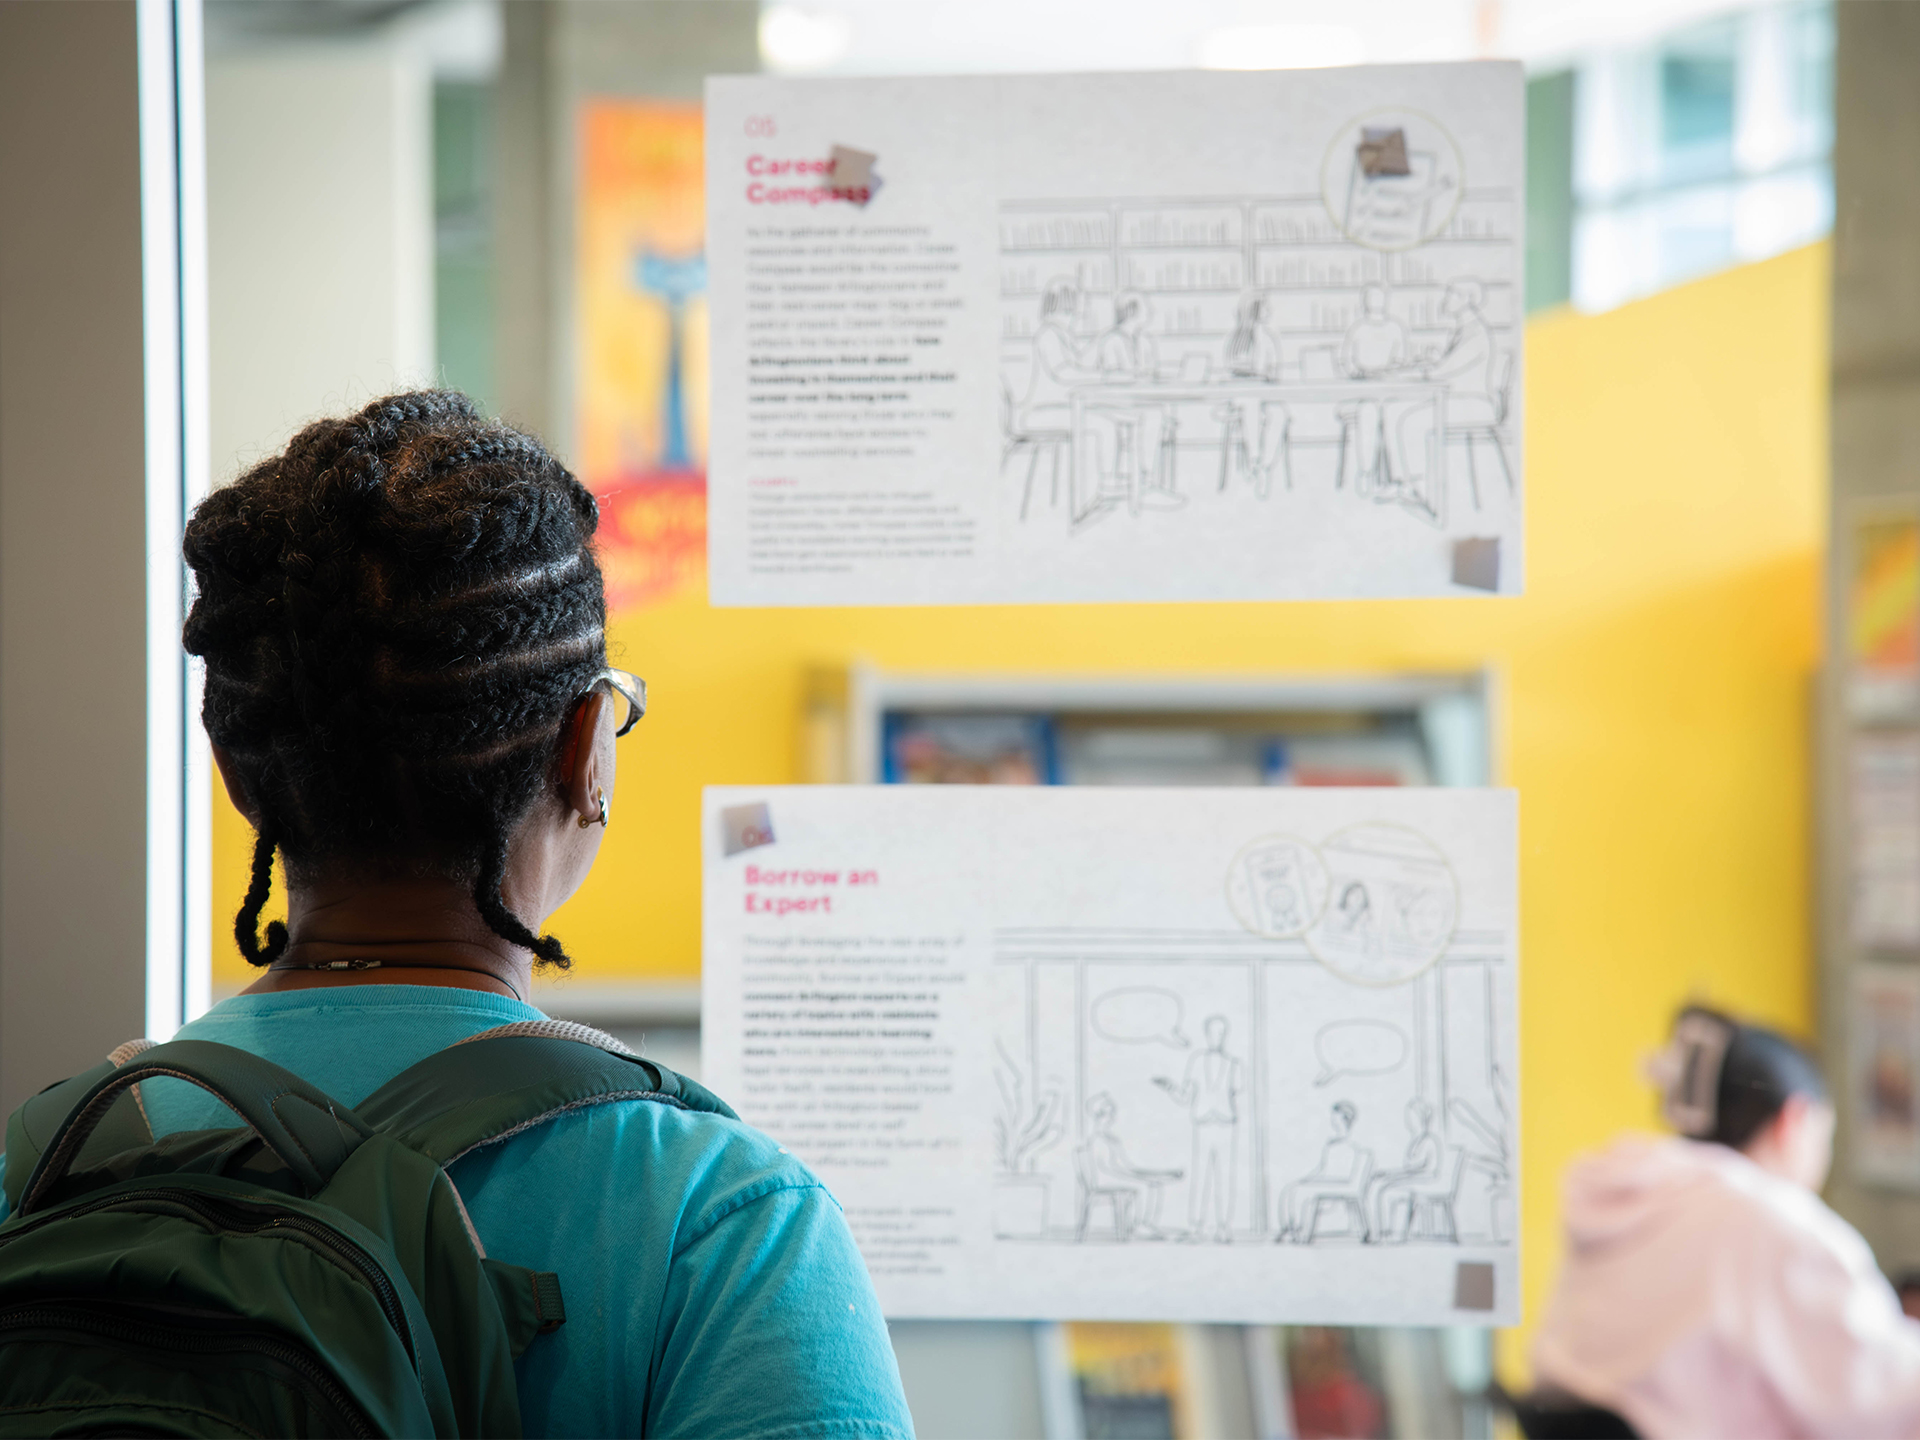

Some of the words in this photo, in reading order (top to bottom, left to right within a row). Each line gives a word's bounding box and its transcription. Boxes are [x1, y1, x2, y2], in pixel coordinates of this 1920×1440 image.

[746, 155, 839, 176] Career
[744, 866, 839, 886] Borrow
[848, 869, 879, 886] an
[744, 894, 832, 916] Expert
